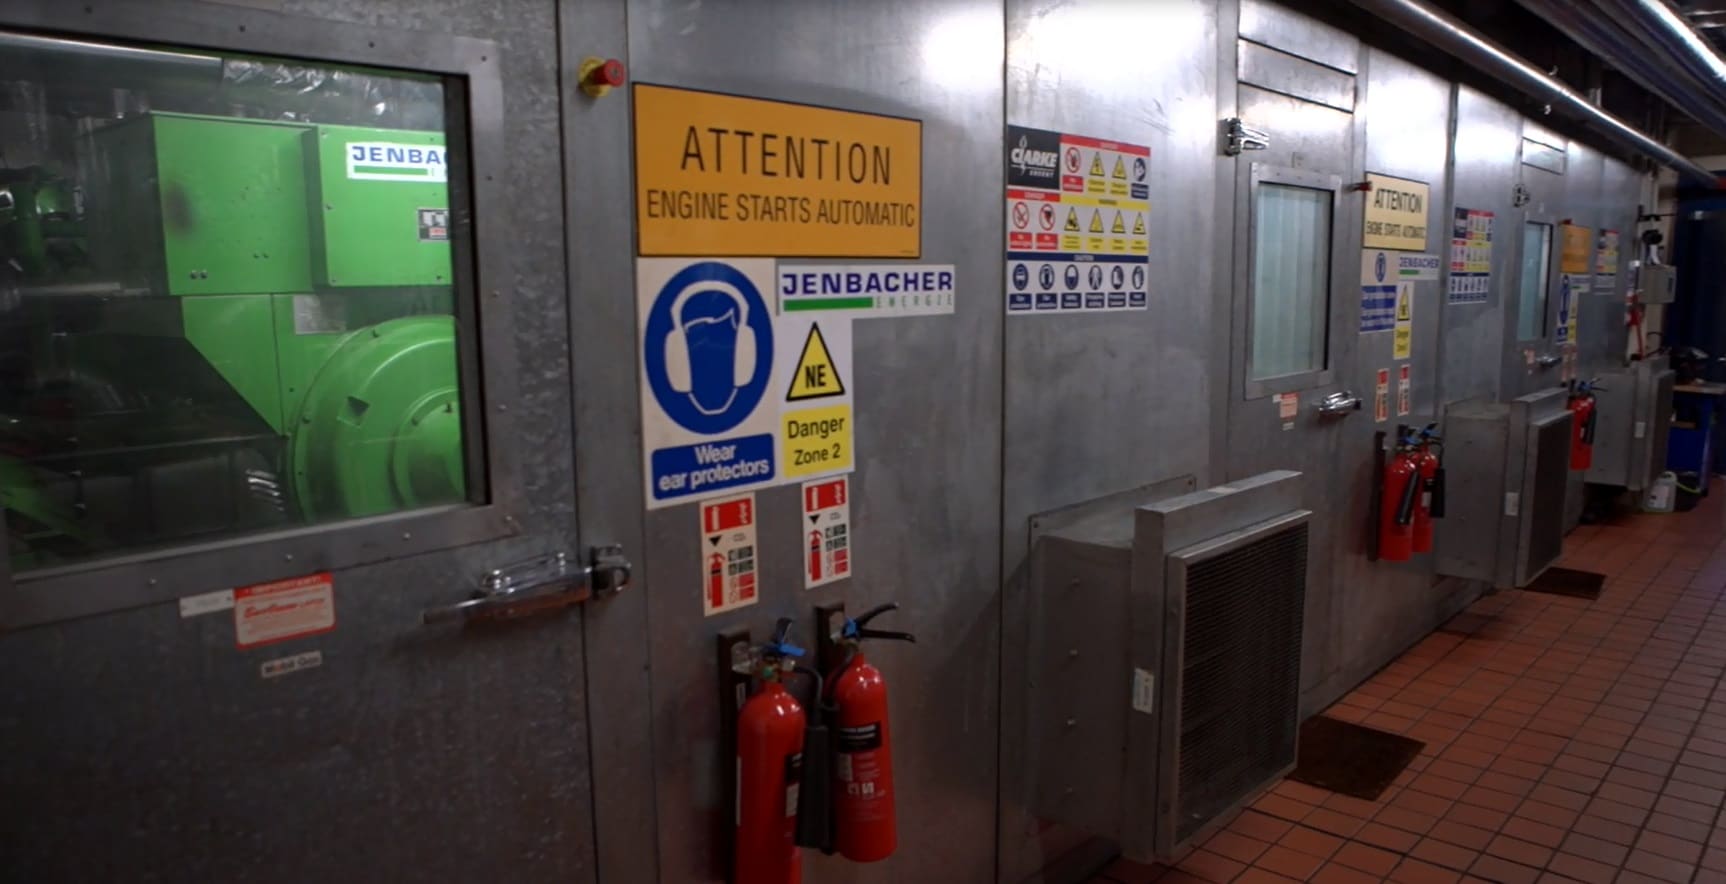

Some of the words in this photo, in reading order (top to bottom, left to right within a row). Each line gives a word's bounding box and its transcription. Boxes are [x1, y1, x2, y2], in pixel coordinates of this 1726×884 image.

[352, 145, 449, 165] JENBA
[681, 125, 890, 185] ATTENTION
[1010, 146, 1058, 168] CLARKE
[646, 189, 729, 221] ENGINE
[736, 194, 811, 223] STARTS
[816, 200, 915, 228] AUTOMATIC
[1374, 188, 1422, 213] ATTENTION
[782, 272, 952, 295] JENBACHER
[805, 364, 826, 388] NE
[787, 417, 845, 439] Danger
[694, 445, 736, 465] Wear
[794, 449, 828, 466] Zone
[832, 443, 841, 459] 2
[659, 472, 687, 491] ear
[690, 459, 770, 490] protectors
